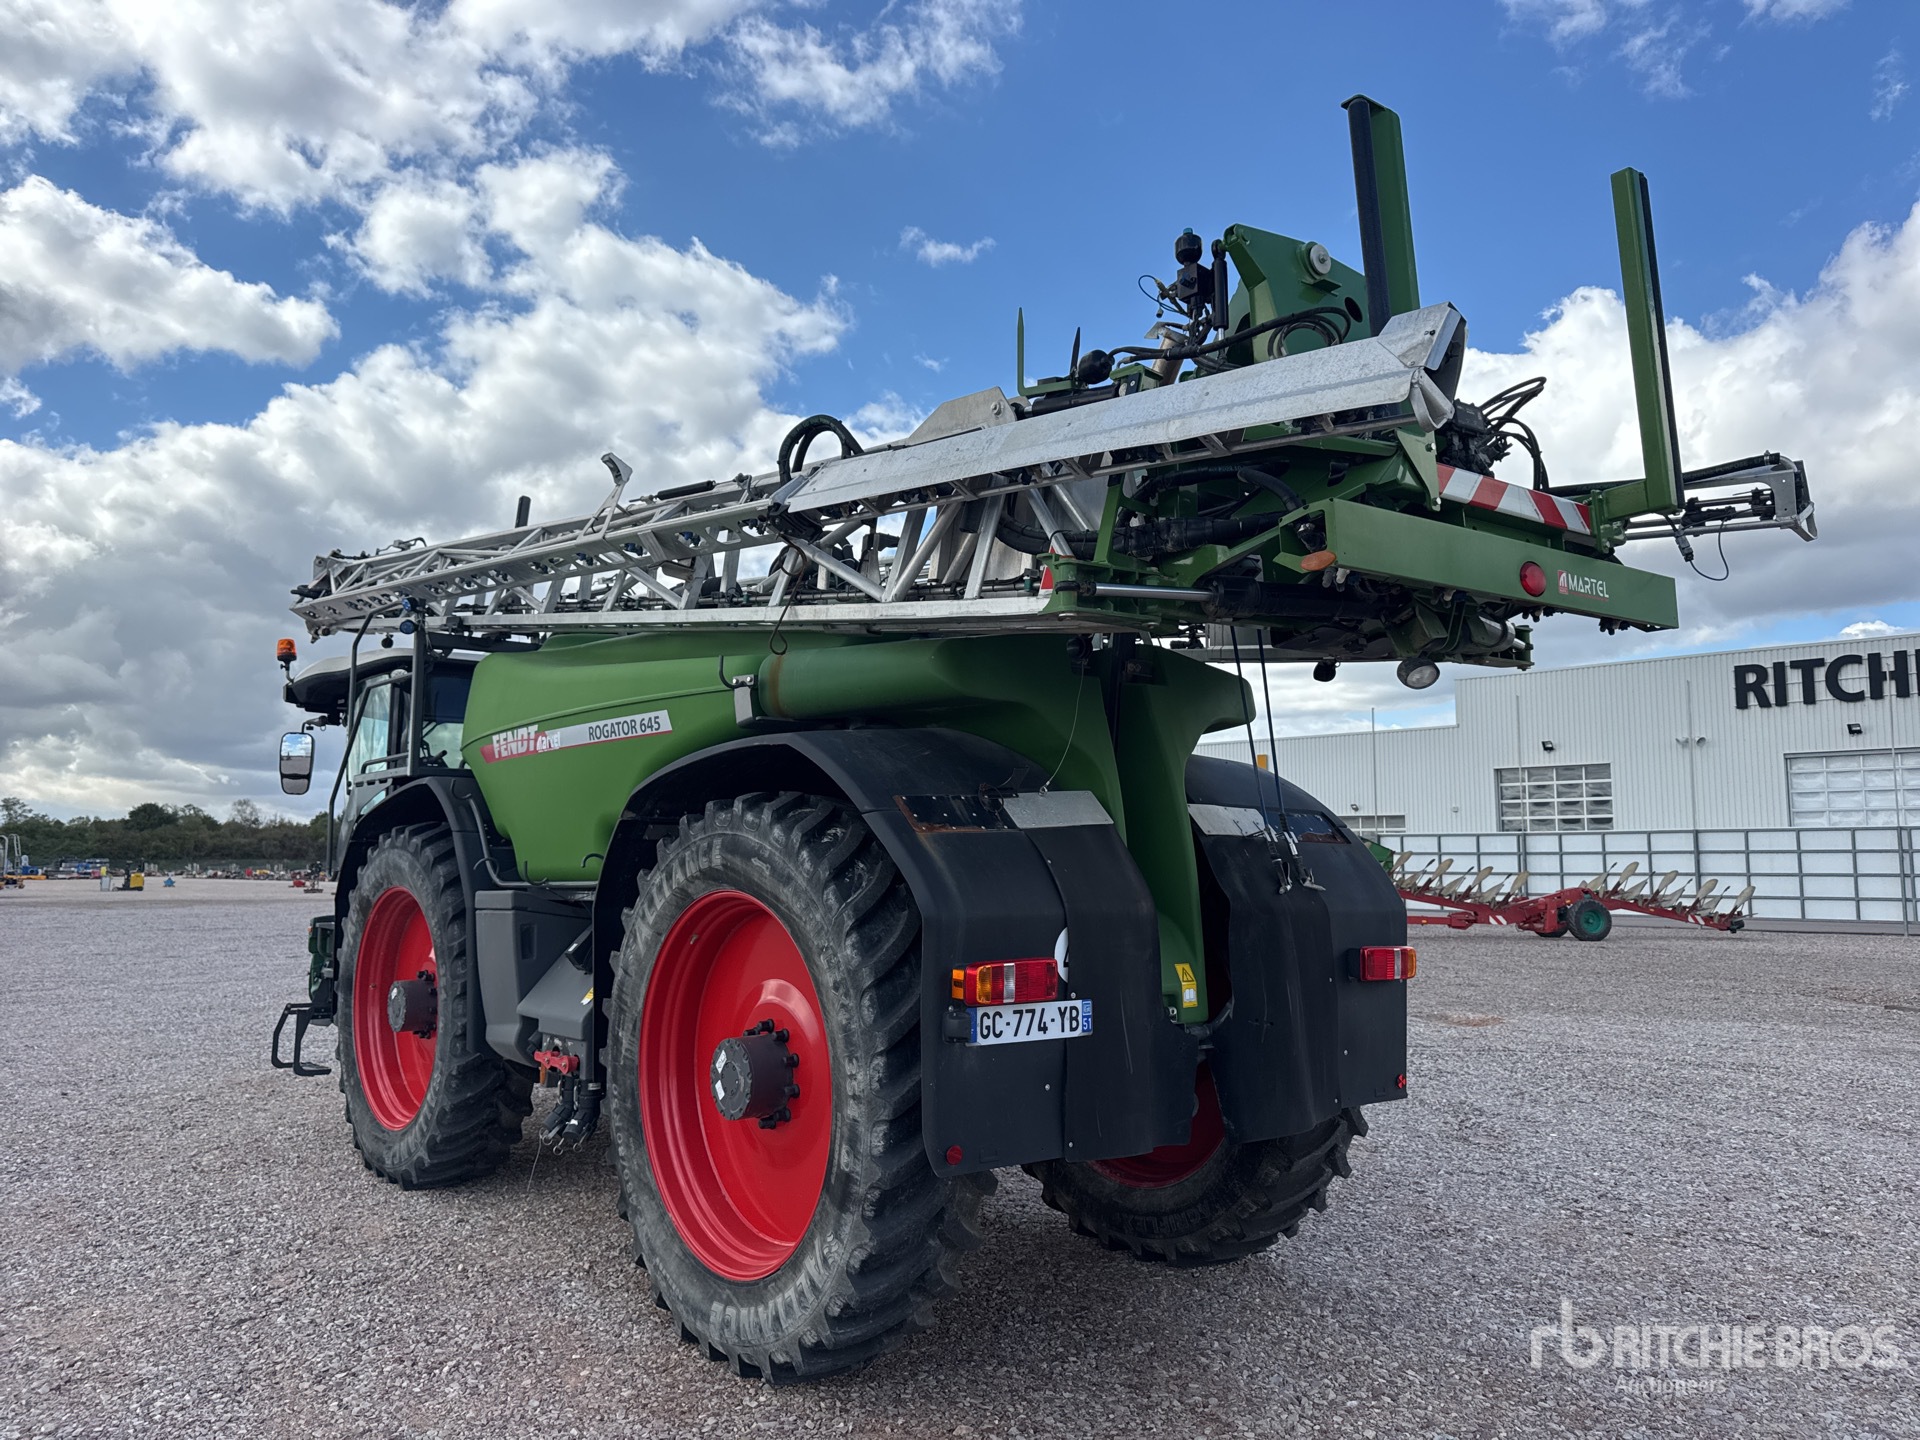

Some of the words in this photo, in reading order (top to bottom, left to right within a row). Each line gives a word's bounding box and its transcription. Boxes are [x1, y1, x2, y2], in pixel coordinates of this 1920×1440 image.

[1568, 573, 1610, 598] MARTEL
[492, 724, 539, 759] FENDT
[588, 720, 638, 742] ROGATOR
[639, 715, 661, 734] 645
[980, 1005, 1080, 1040] GC-774-YB
[1083, 1017, 1092, 1031] 51
